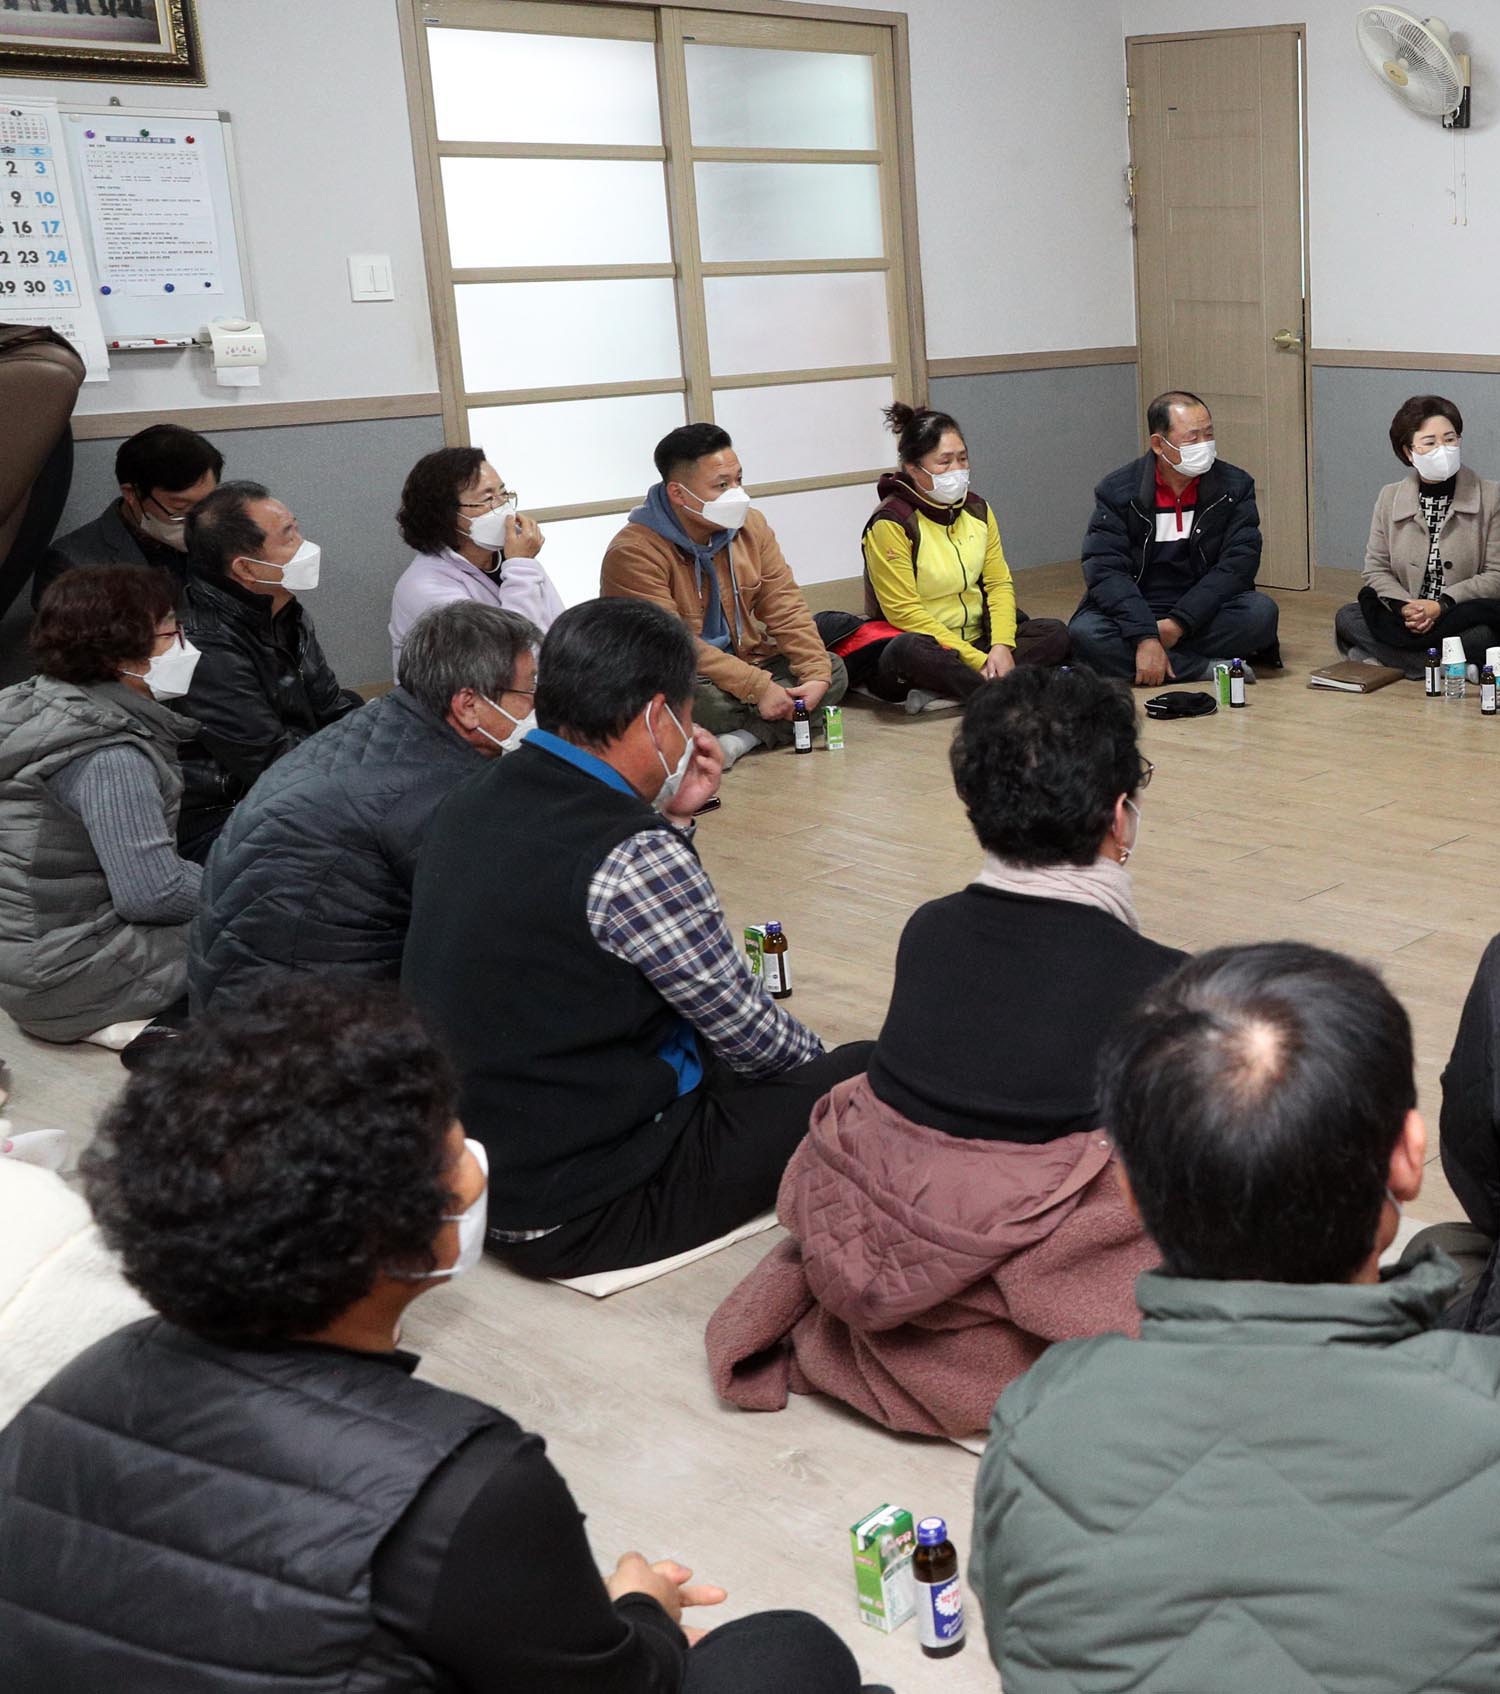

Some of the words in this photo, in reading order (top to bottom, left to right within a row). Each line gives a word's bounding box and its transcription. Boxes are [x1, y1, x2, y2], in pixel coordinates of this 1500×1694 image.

[6, 160, 18, 174] 2
[34, 161, 46, 174] 3
[10, 190, 22, 204] 9
[35, 191, 55, 204] 10
[12, 220, 33, 234] 16
[41, 220, 61, 234] 17
[0, 250, 11, 264] 2
[17, 250, 39, 264] 23
[46, 250, 68, 264] 24
[23, 280, 46, 293] 30
[53, 280, 73, 293] 31
